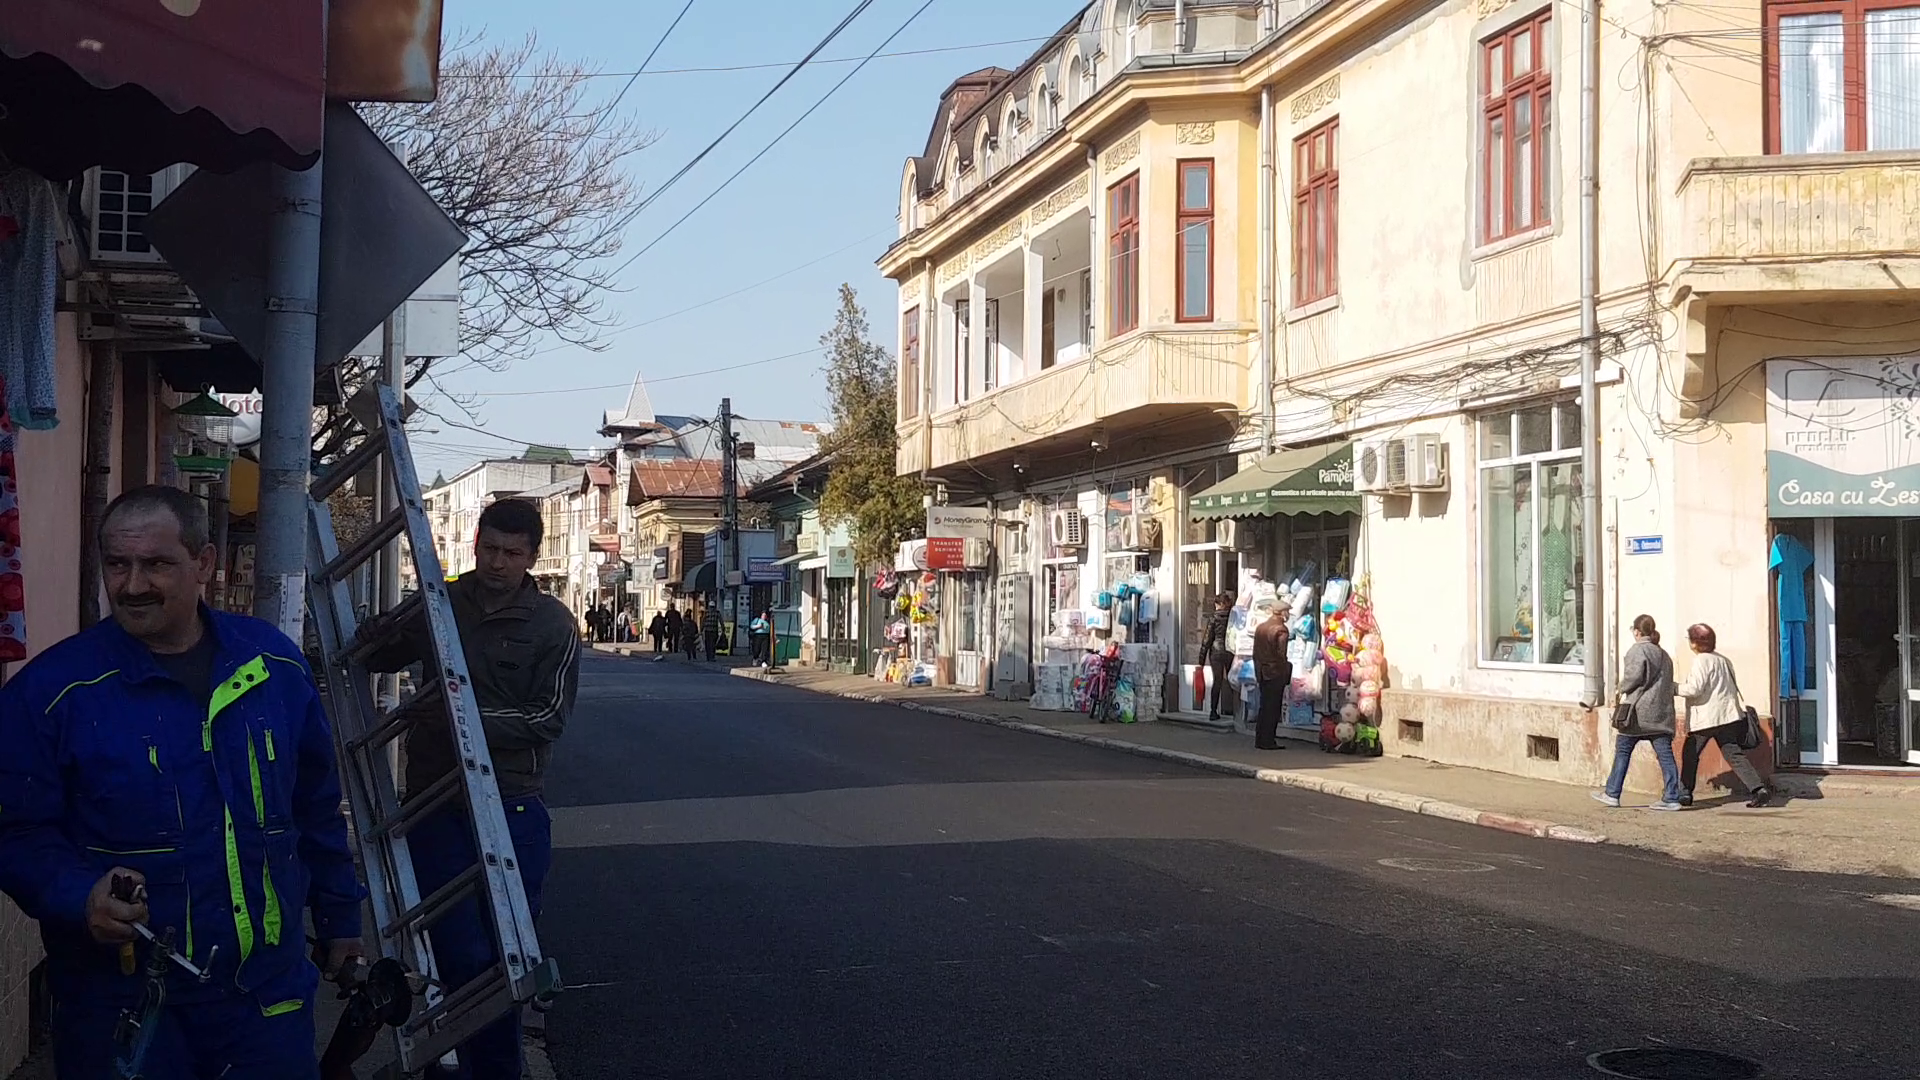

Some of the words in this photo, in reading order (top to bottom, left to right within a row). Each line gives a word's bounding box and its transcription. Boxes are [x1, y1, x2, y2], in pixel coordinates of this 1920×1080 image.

[1318, 468, 1354, 487] Pamper
[1778, 479, 1835, 506] Casa
[1840, 490, 1864, 505] cu
[1868, 476, 1920, 507] Zes
[943, 516, 983, 525] MoneyGram
